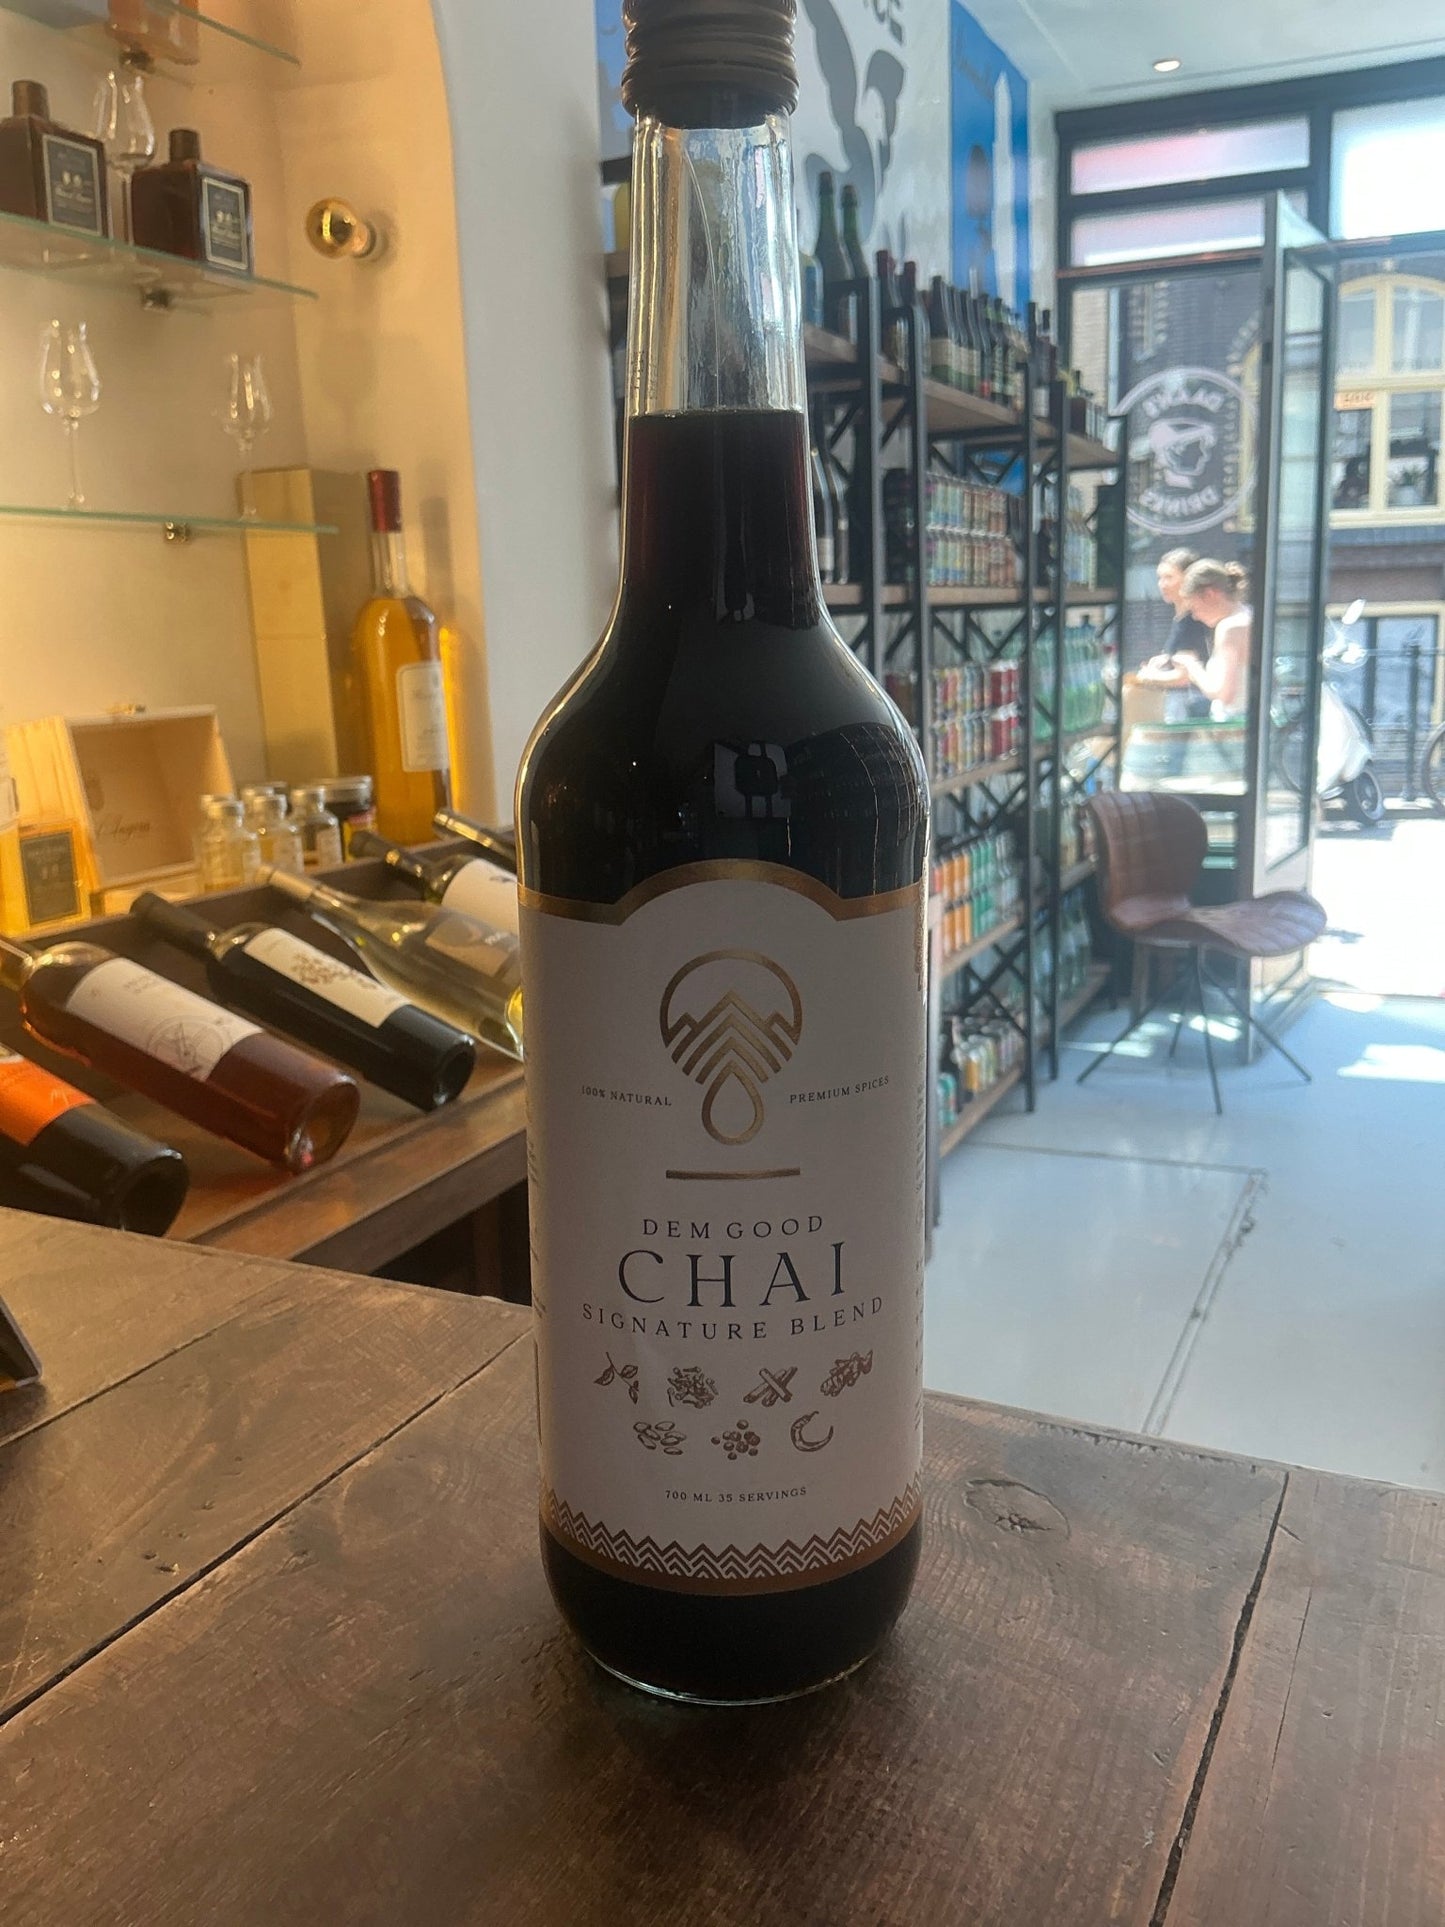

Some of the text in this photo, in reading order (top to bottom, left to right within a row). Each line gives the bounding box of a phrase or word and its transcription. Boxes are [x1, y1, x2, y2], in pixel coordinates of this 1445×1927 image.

[581, 1085, 672, 1107] 100% NATURAL
[789, 1075, 890, 1105] PREMIUM SPICES
[643, 1215, 823, 1240] DEM GOOD
[618, 1241, 846, 1308] CHAI
[582, 1296, 883, 1340] SIGNATURE BLEND
[665, 1487, 807, 1503] 700 ML 35 SERVINGS
